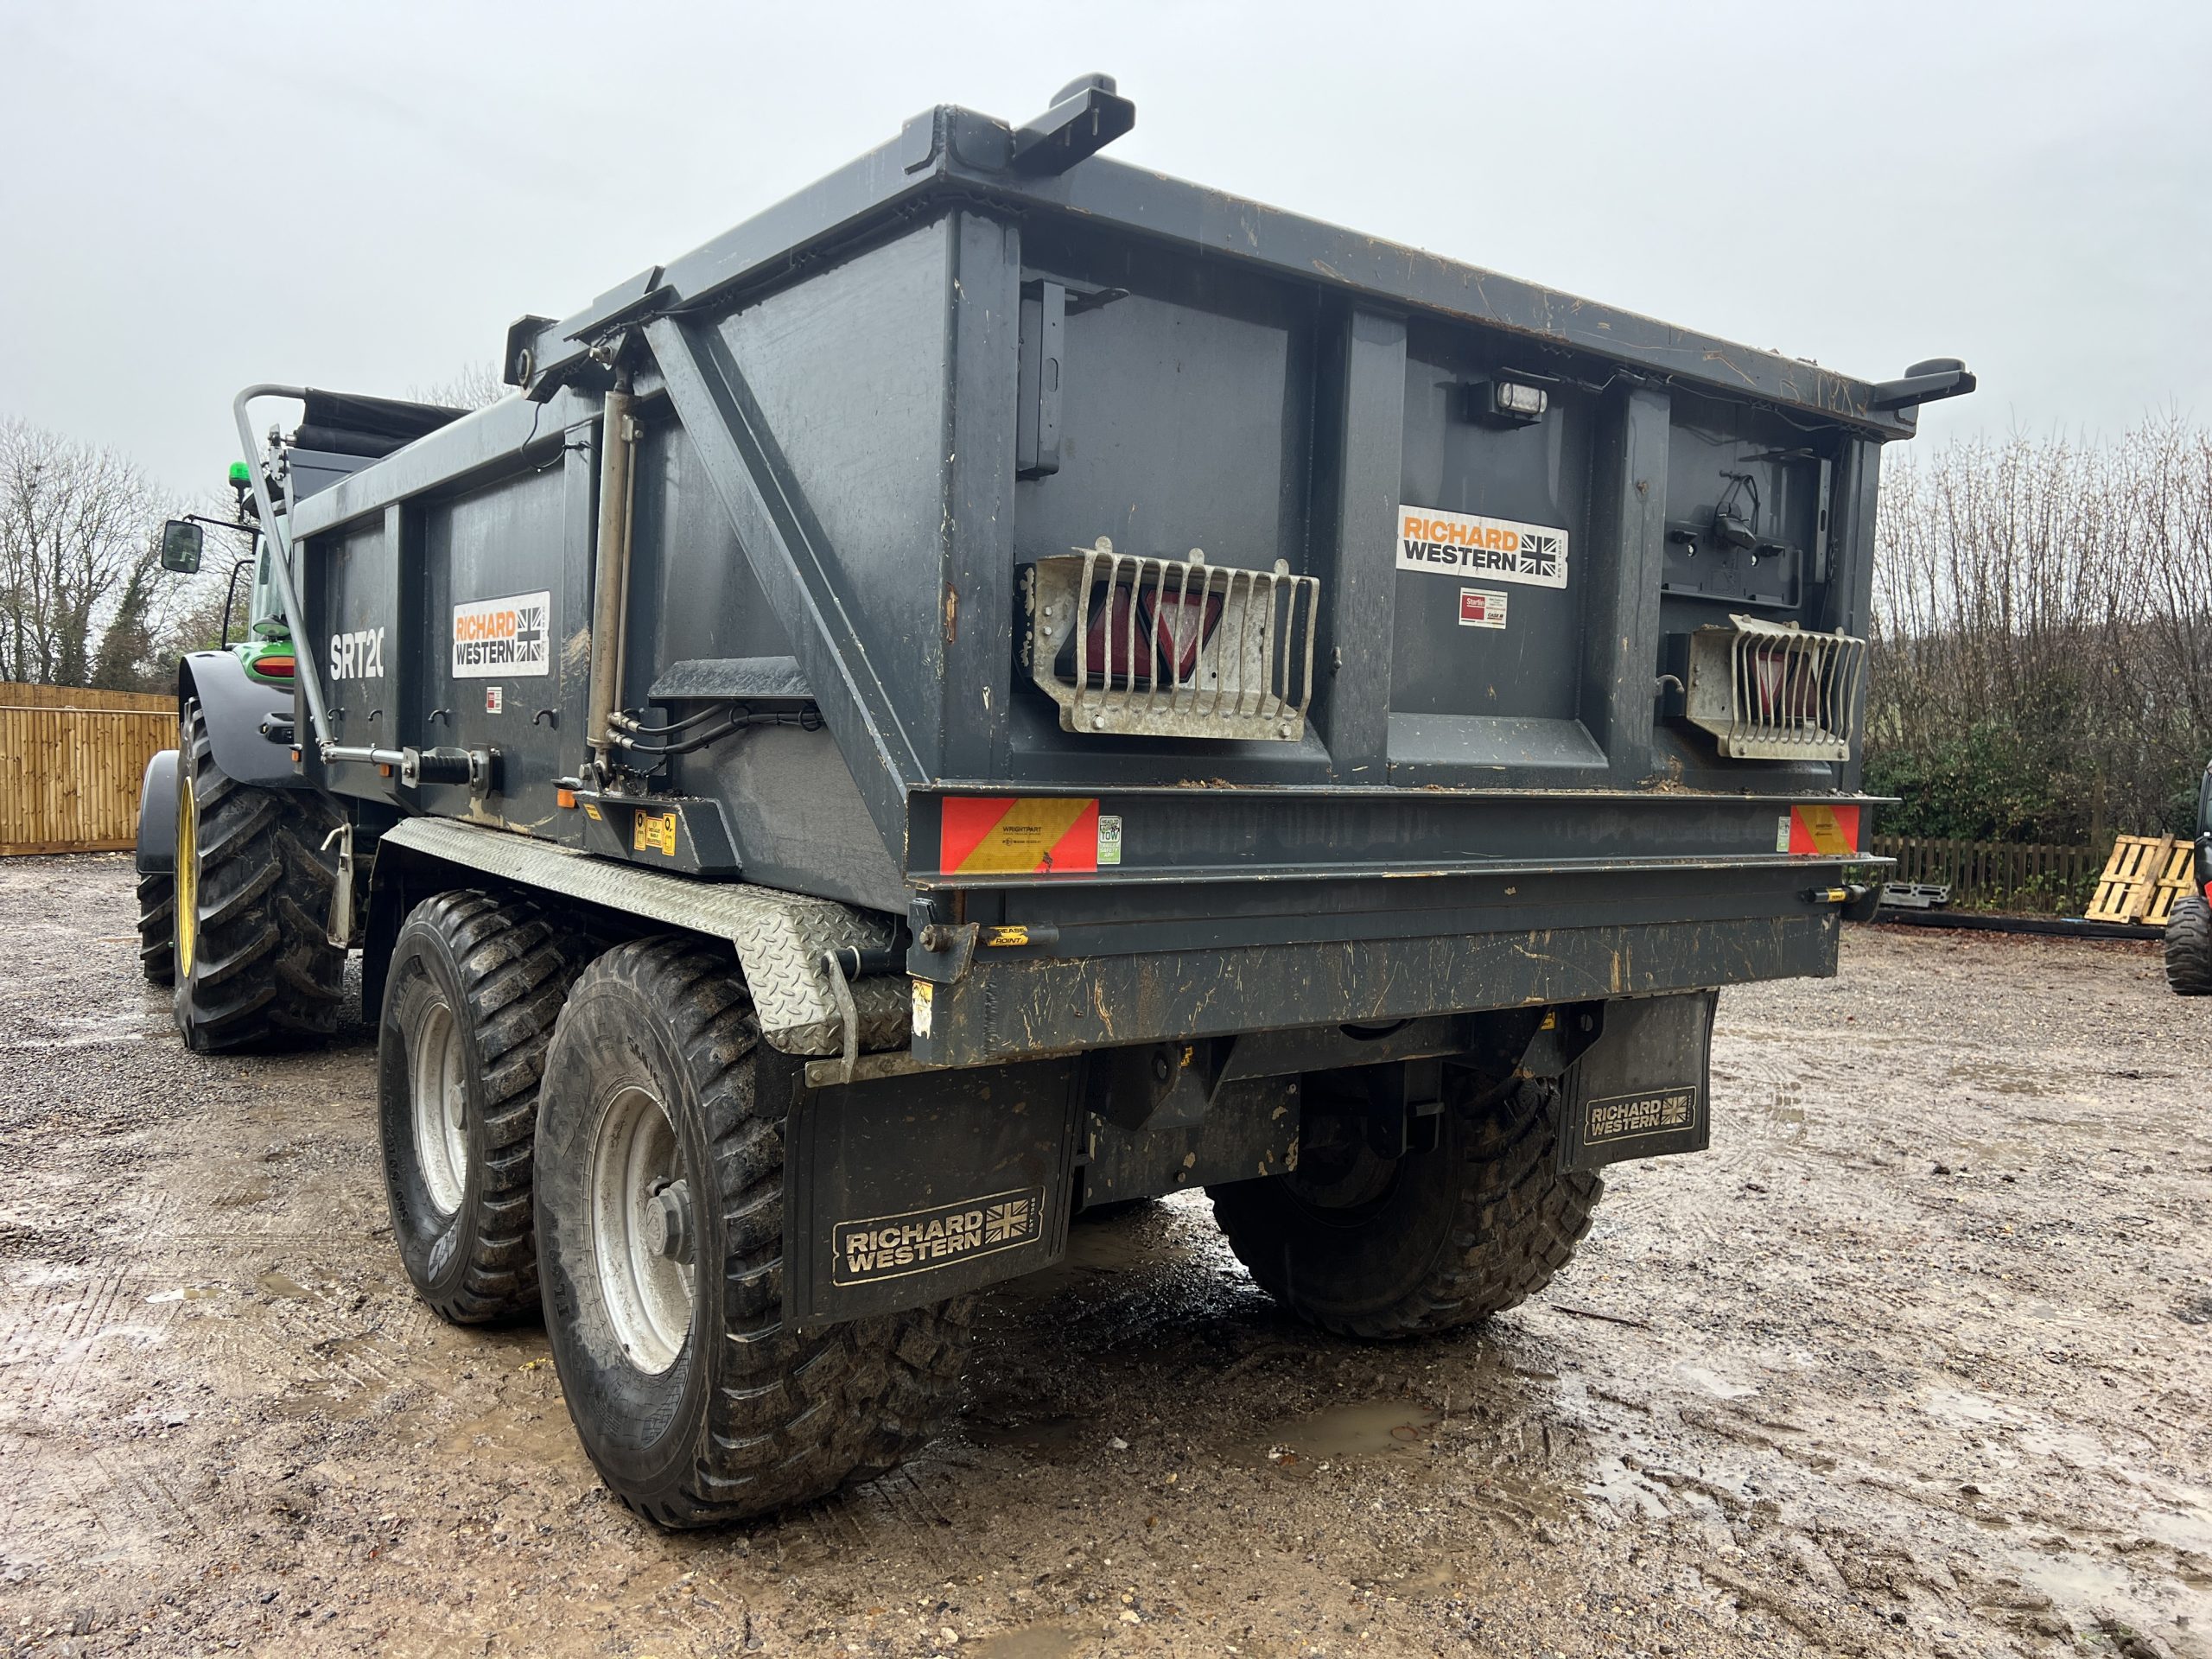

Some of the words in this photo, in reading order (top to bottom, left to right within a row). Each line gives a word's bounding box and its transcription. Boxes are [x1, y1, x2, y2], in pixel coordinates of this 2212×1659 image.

[1403, 516, 1518, 551] RICHARD
[1403, 539, 1516, 572] WESTERN
[456, 610, 517, 642] RICHARD
[456, 639, 515, 665] WESTERN
[1101, 830, 1119, 841] TOW
[1591, 1099, 1662, 1124] RICHARD
[1591, 1113, 1660, 1137] WESTERN
[846, 1210, 984, 1255] RICHARD
[846, 1229, 982, 1274] WESTERN
